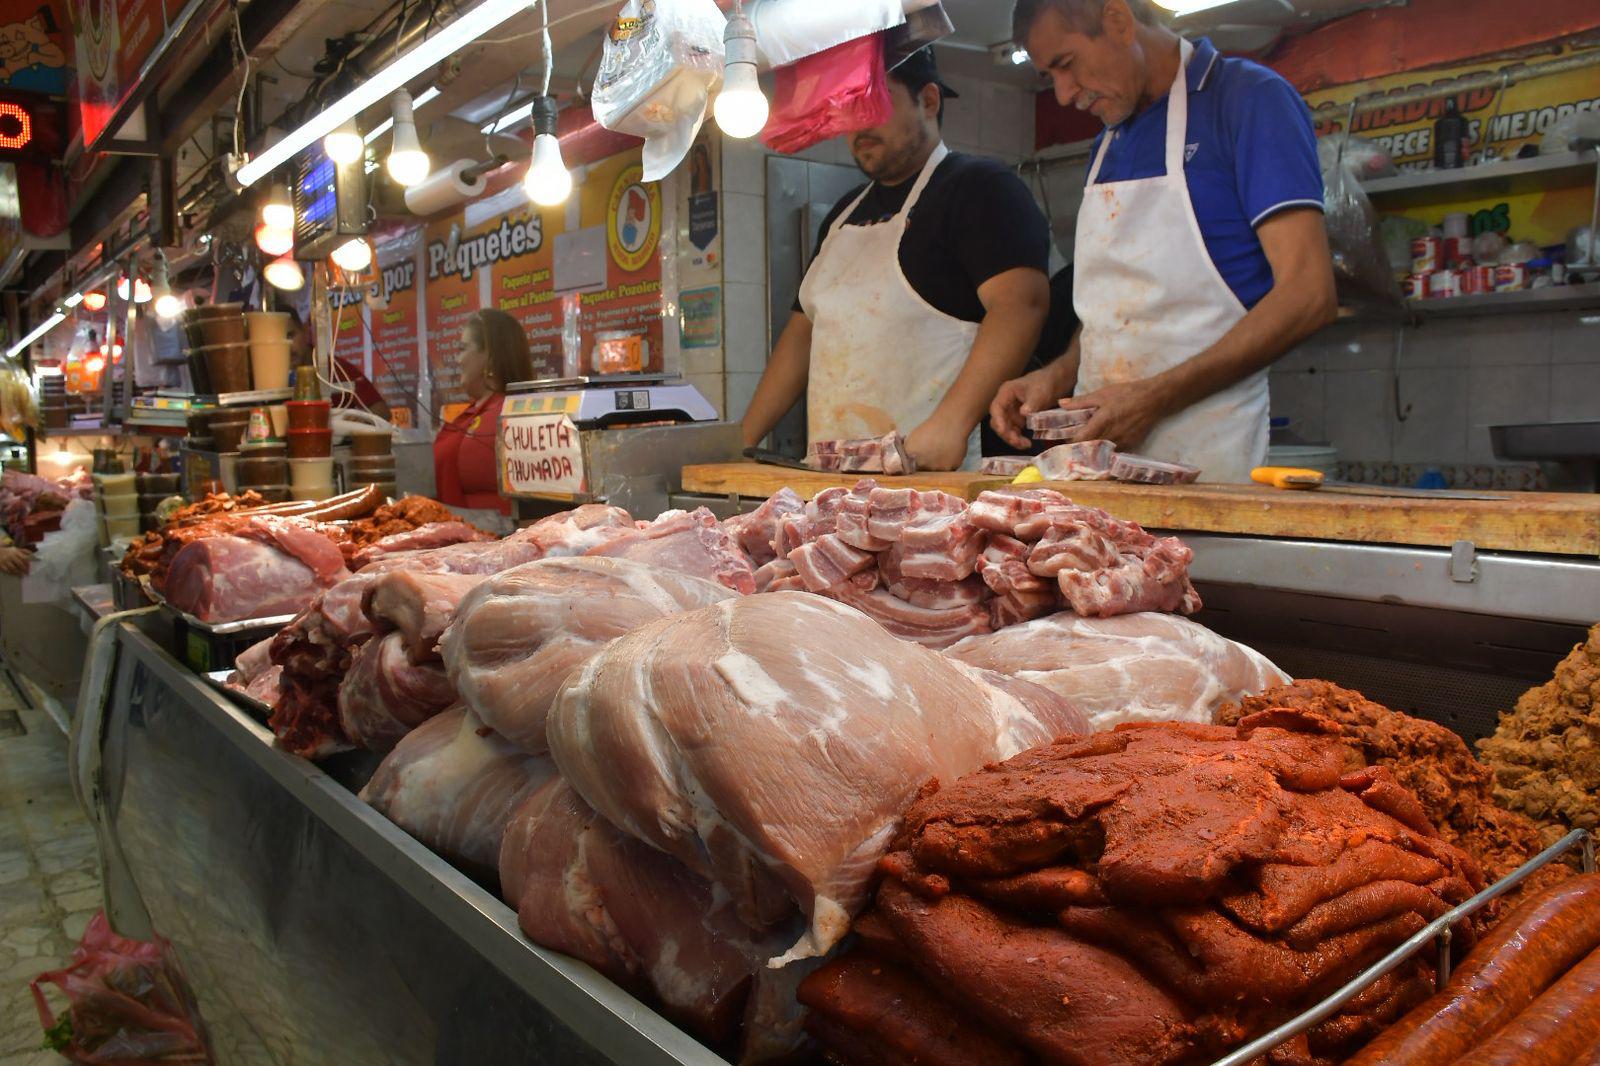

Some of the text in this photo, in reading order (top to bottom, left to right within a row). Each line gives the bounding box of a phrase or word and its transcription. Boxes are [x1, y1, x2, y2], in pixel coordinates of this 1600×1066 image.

[428, 216, 542, 278] Paquetes
[383, 262, 415, 302] por
[504, 420, 570, 451] CHULETA
[506, 456, 573, 482] AHUMADA
